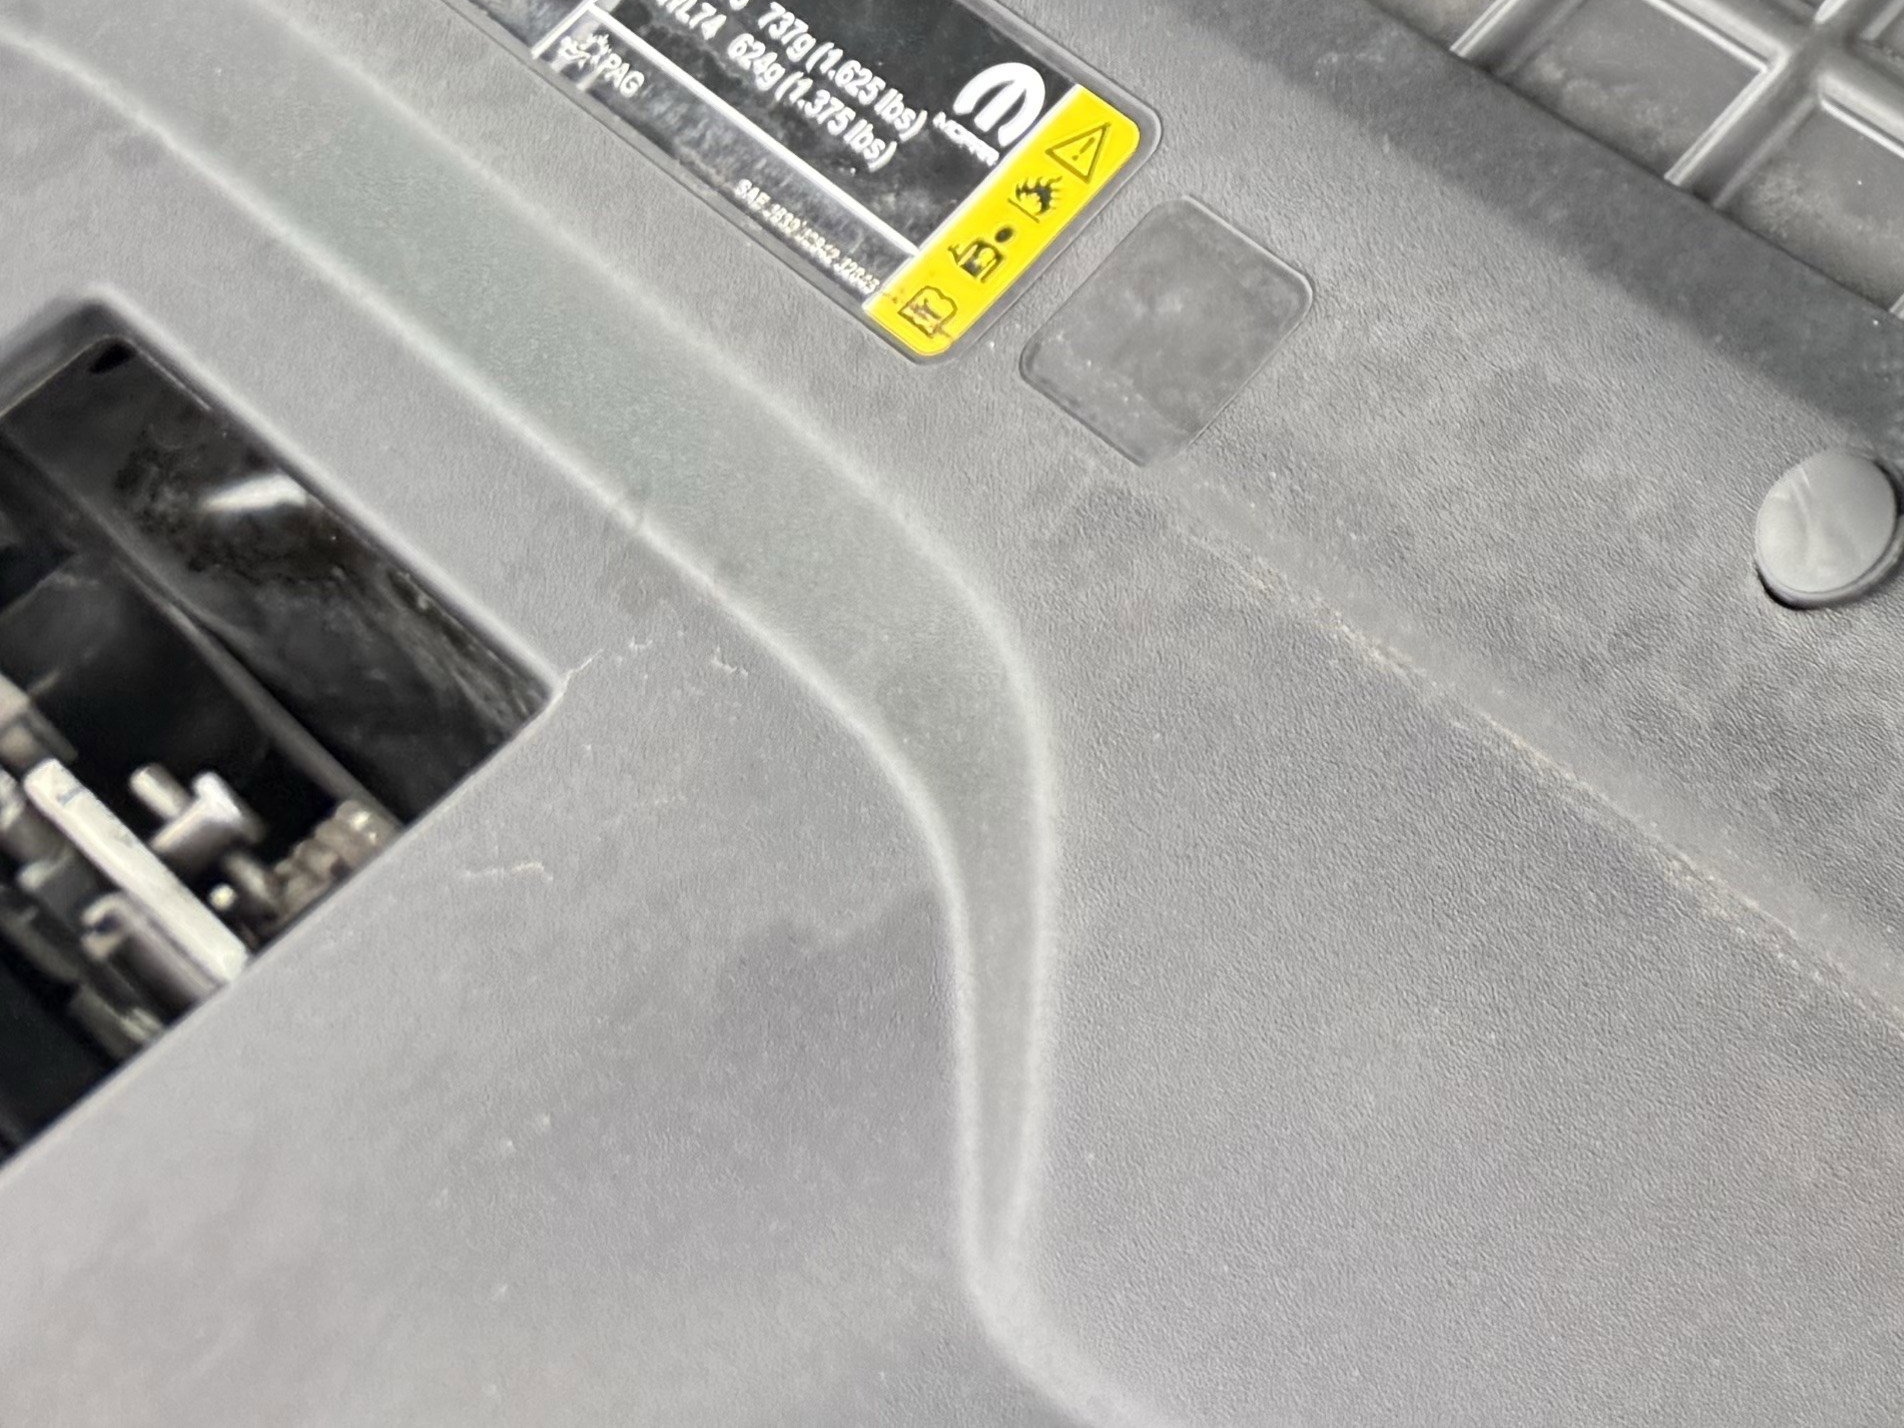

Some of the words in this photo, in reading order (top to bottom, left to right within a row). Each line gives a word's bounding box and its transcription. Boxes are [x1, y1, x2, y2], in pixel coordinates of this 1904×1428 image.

[598, 53, 645, 97] PAG
[727, 33, 785, 91] 624g
[775, 72, 856, 136] (1.375
[844, 119, 898, 172] lbs)
[757, 1, 816, 62] 737g
[806, 42, 886, 105] (1.625
[874, 88, 928, 142] lbs)
